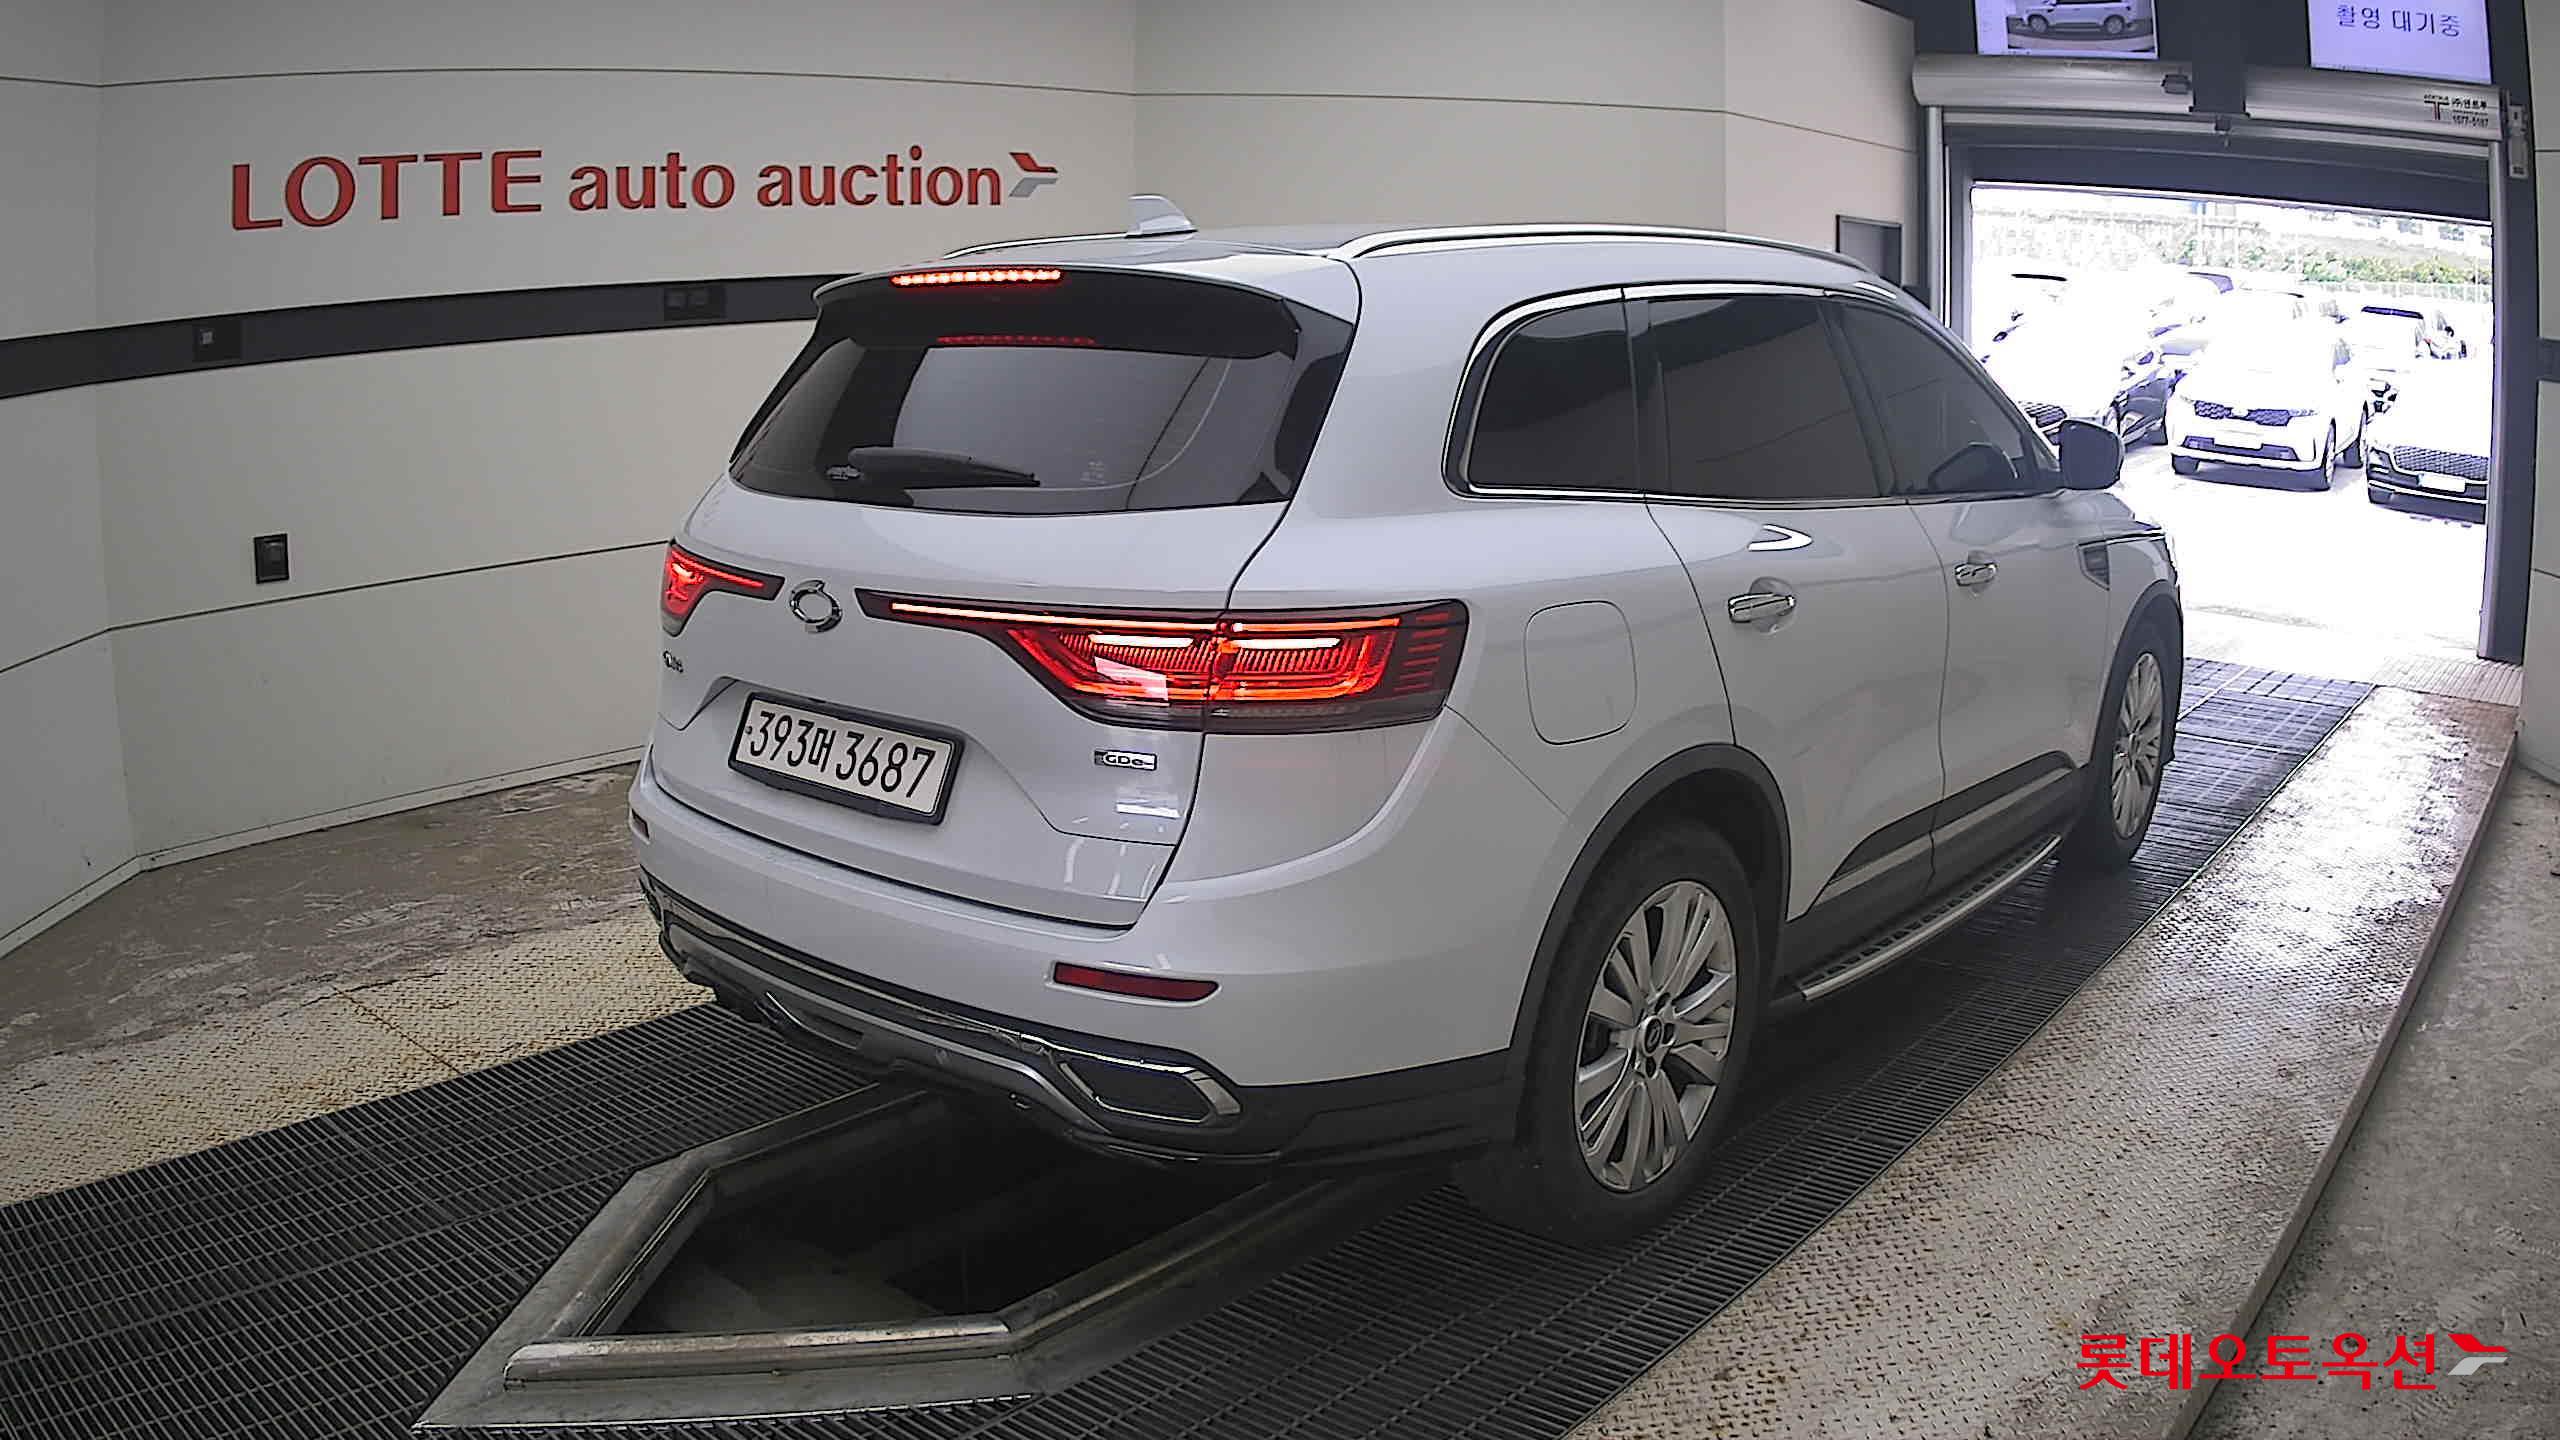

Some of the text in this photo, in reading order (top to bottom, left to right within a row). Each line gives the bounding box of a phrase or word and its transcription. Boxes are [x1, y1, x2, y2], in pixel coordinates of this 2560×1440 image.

[2392, 9, 2461, 37] 대기중
[232, 146, 1002, 231] LOTTE auto auction
